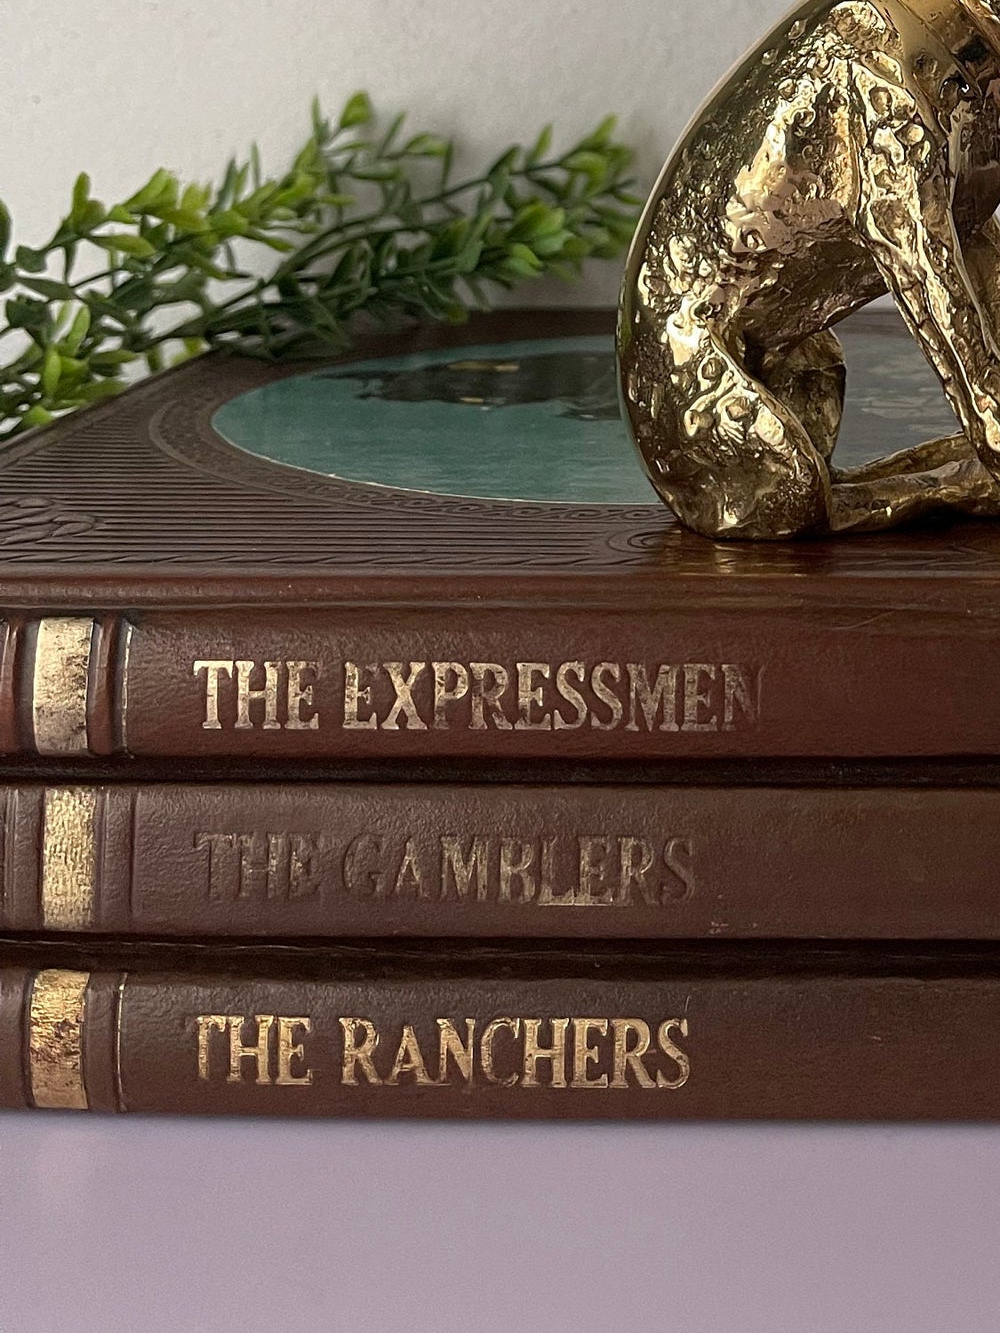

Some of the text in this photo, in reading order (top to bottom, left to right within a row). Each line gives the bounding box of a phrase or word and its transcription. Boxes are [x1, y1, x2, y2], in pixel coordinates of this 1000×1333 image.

[193, 660, 764, 732] THE EXPRESSMEN
[194, 832, 697, 906] THE GAMBLERS
[196, 1014, 691, 1089] THE RANCHERS
